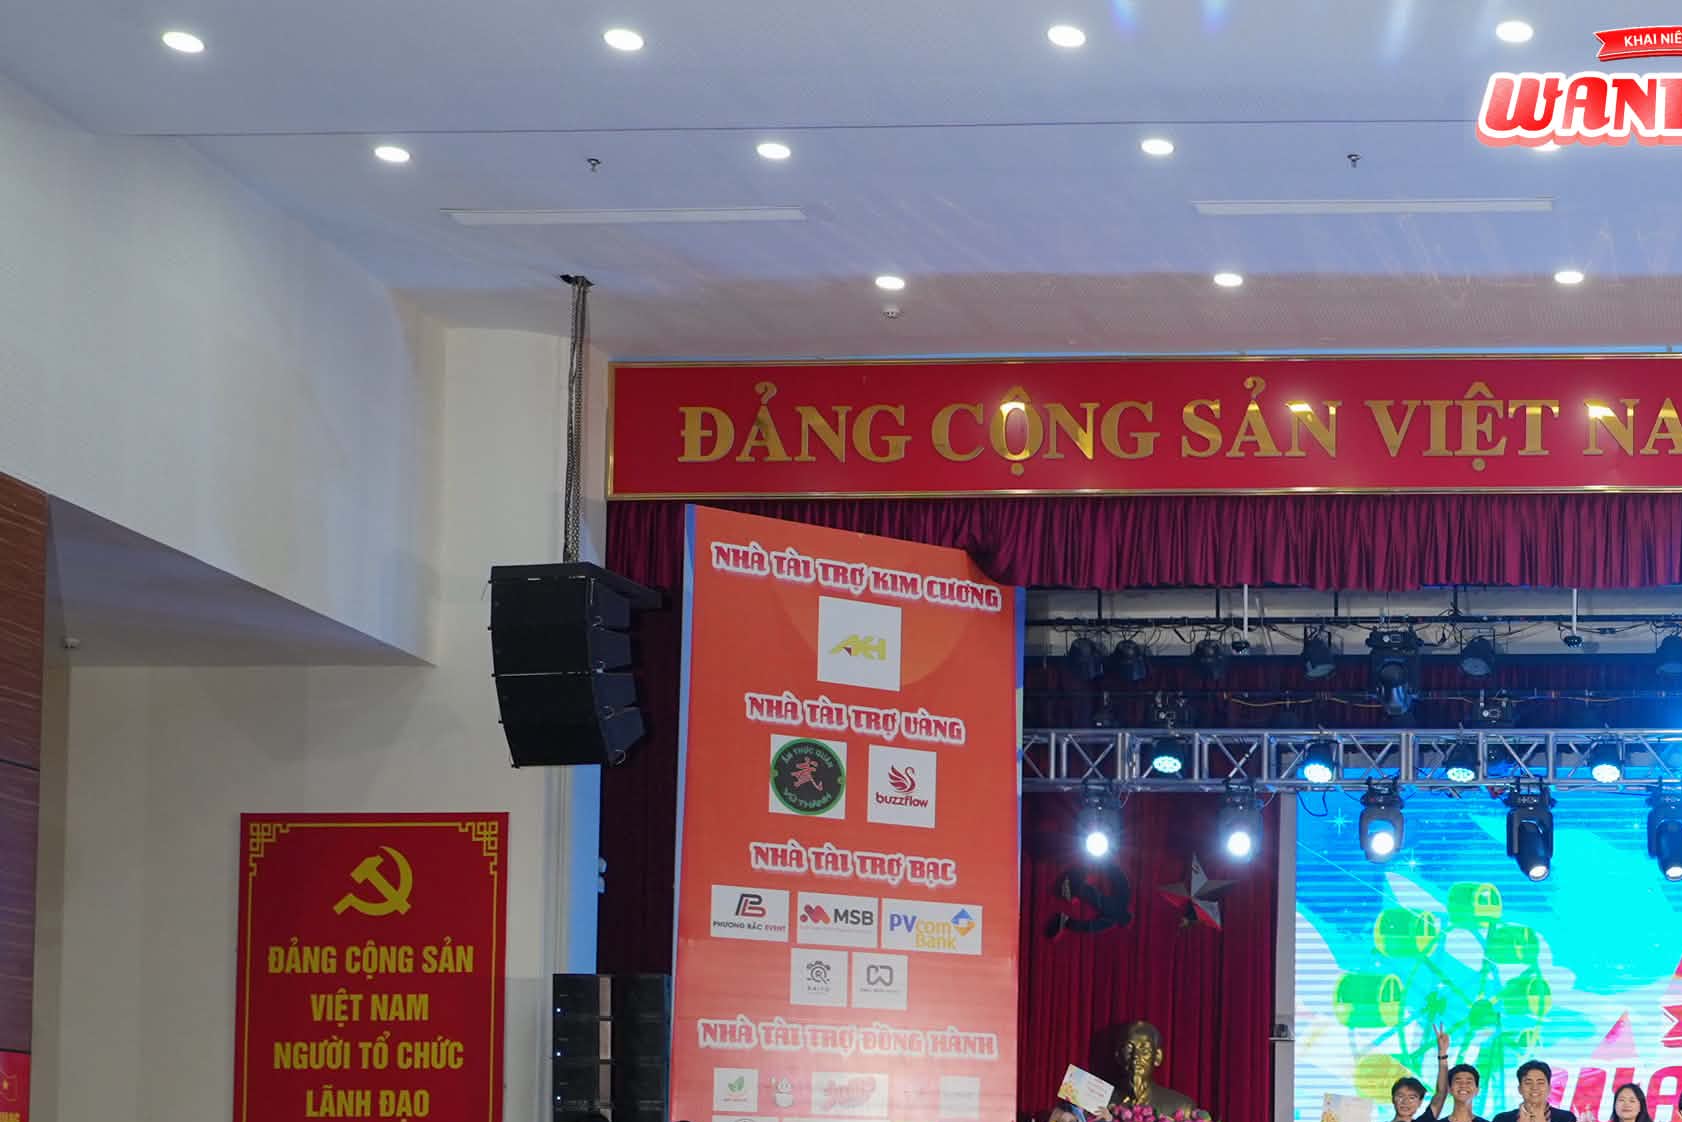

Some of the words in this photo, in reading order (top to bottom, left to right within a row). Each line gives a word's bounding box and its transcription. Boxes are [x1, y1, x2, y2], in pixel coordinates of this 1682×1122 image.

[678, 381, 911, 464] ĐẢNG
[933, 387, 1161, 475] CỘNG
[1181, 374, 1339, 460] SẢN
[1364, 380, 1560, 473] VIỆT
[713, 543, 768, 572] NHÀ
[772, 549, 813, 579] TÀI
[818, 558, 866, 593] TRỢ
[871, 573, 919, 598] KIM
[748, 692, 800, 721] NHÀ
[806, 696, 847, 726] TÀI
[851, 708, 898, 738] TRỢ
[904, 711, 963, 741] VÀNG
[875, 792, 929, 808] buzzflow
[753, 840, 804, 869] NHÀ
[811, 843, 850, 872] TÀI
[856, 853, 902, 884] TRỢ
[908, 858, 956, 887] BẠC
[833, 908, 874, 926] MSB
[268, 936, 337, 974] ĐẢNG
[345, 939, 414, 980] CỘNG
[422, 936, 474, 974] SẢN
[310, 987, 364, 1027] VIỆT
[370, 993, 429, 1022] NAM
[273, 1034, 350, 1070] NGƯỜI
[358, 1030, 391, 1070] TỔ
[397, 1035, 465, 1070] CHỨC
[305, 1084, 372, 1118] LÃNH
[379, 1089, 430, 1122] ĐẠO
